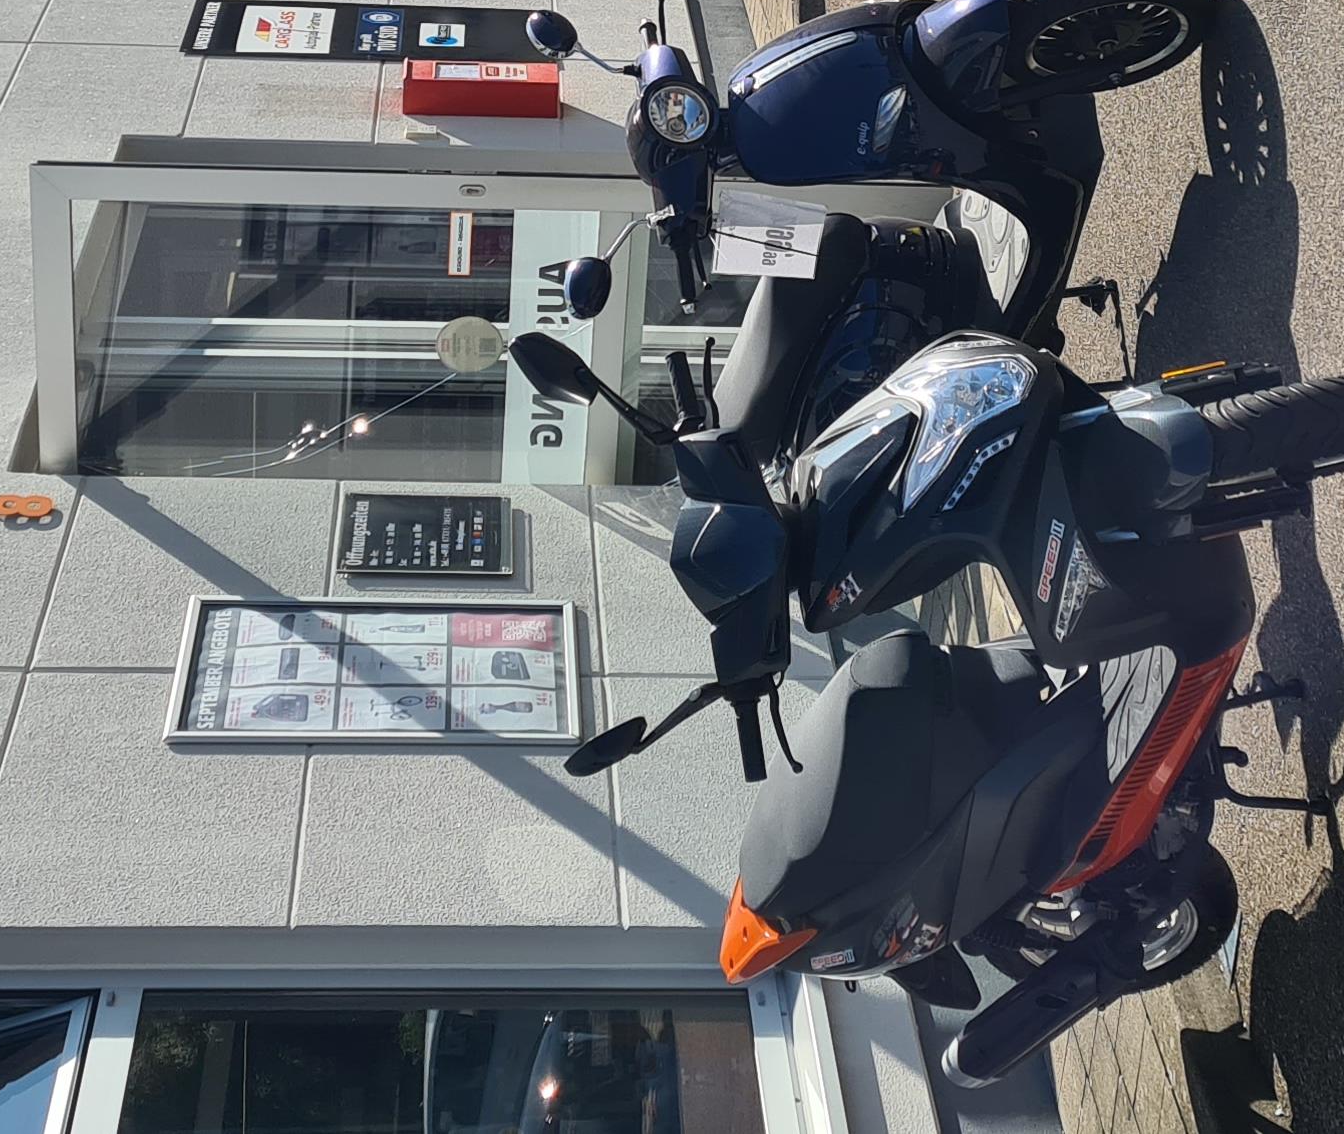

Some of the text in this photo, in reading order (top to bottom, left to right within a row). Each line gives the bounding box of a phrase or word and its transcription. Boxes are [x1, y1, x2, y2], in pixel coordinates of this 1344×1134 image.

[192, 1, 222, 50] UNSERE PARTNER
[856, 122, 870, 154] e-quip
[341, 500, 371, 566] Öffnungszeiten
[1037, 534, 1062, 602] SPEED
[196, 610, 232, 729] SEPTEMBER ANGEBOTE
